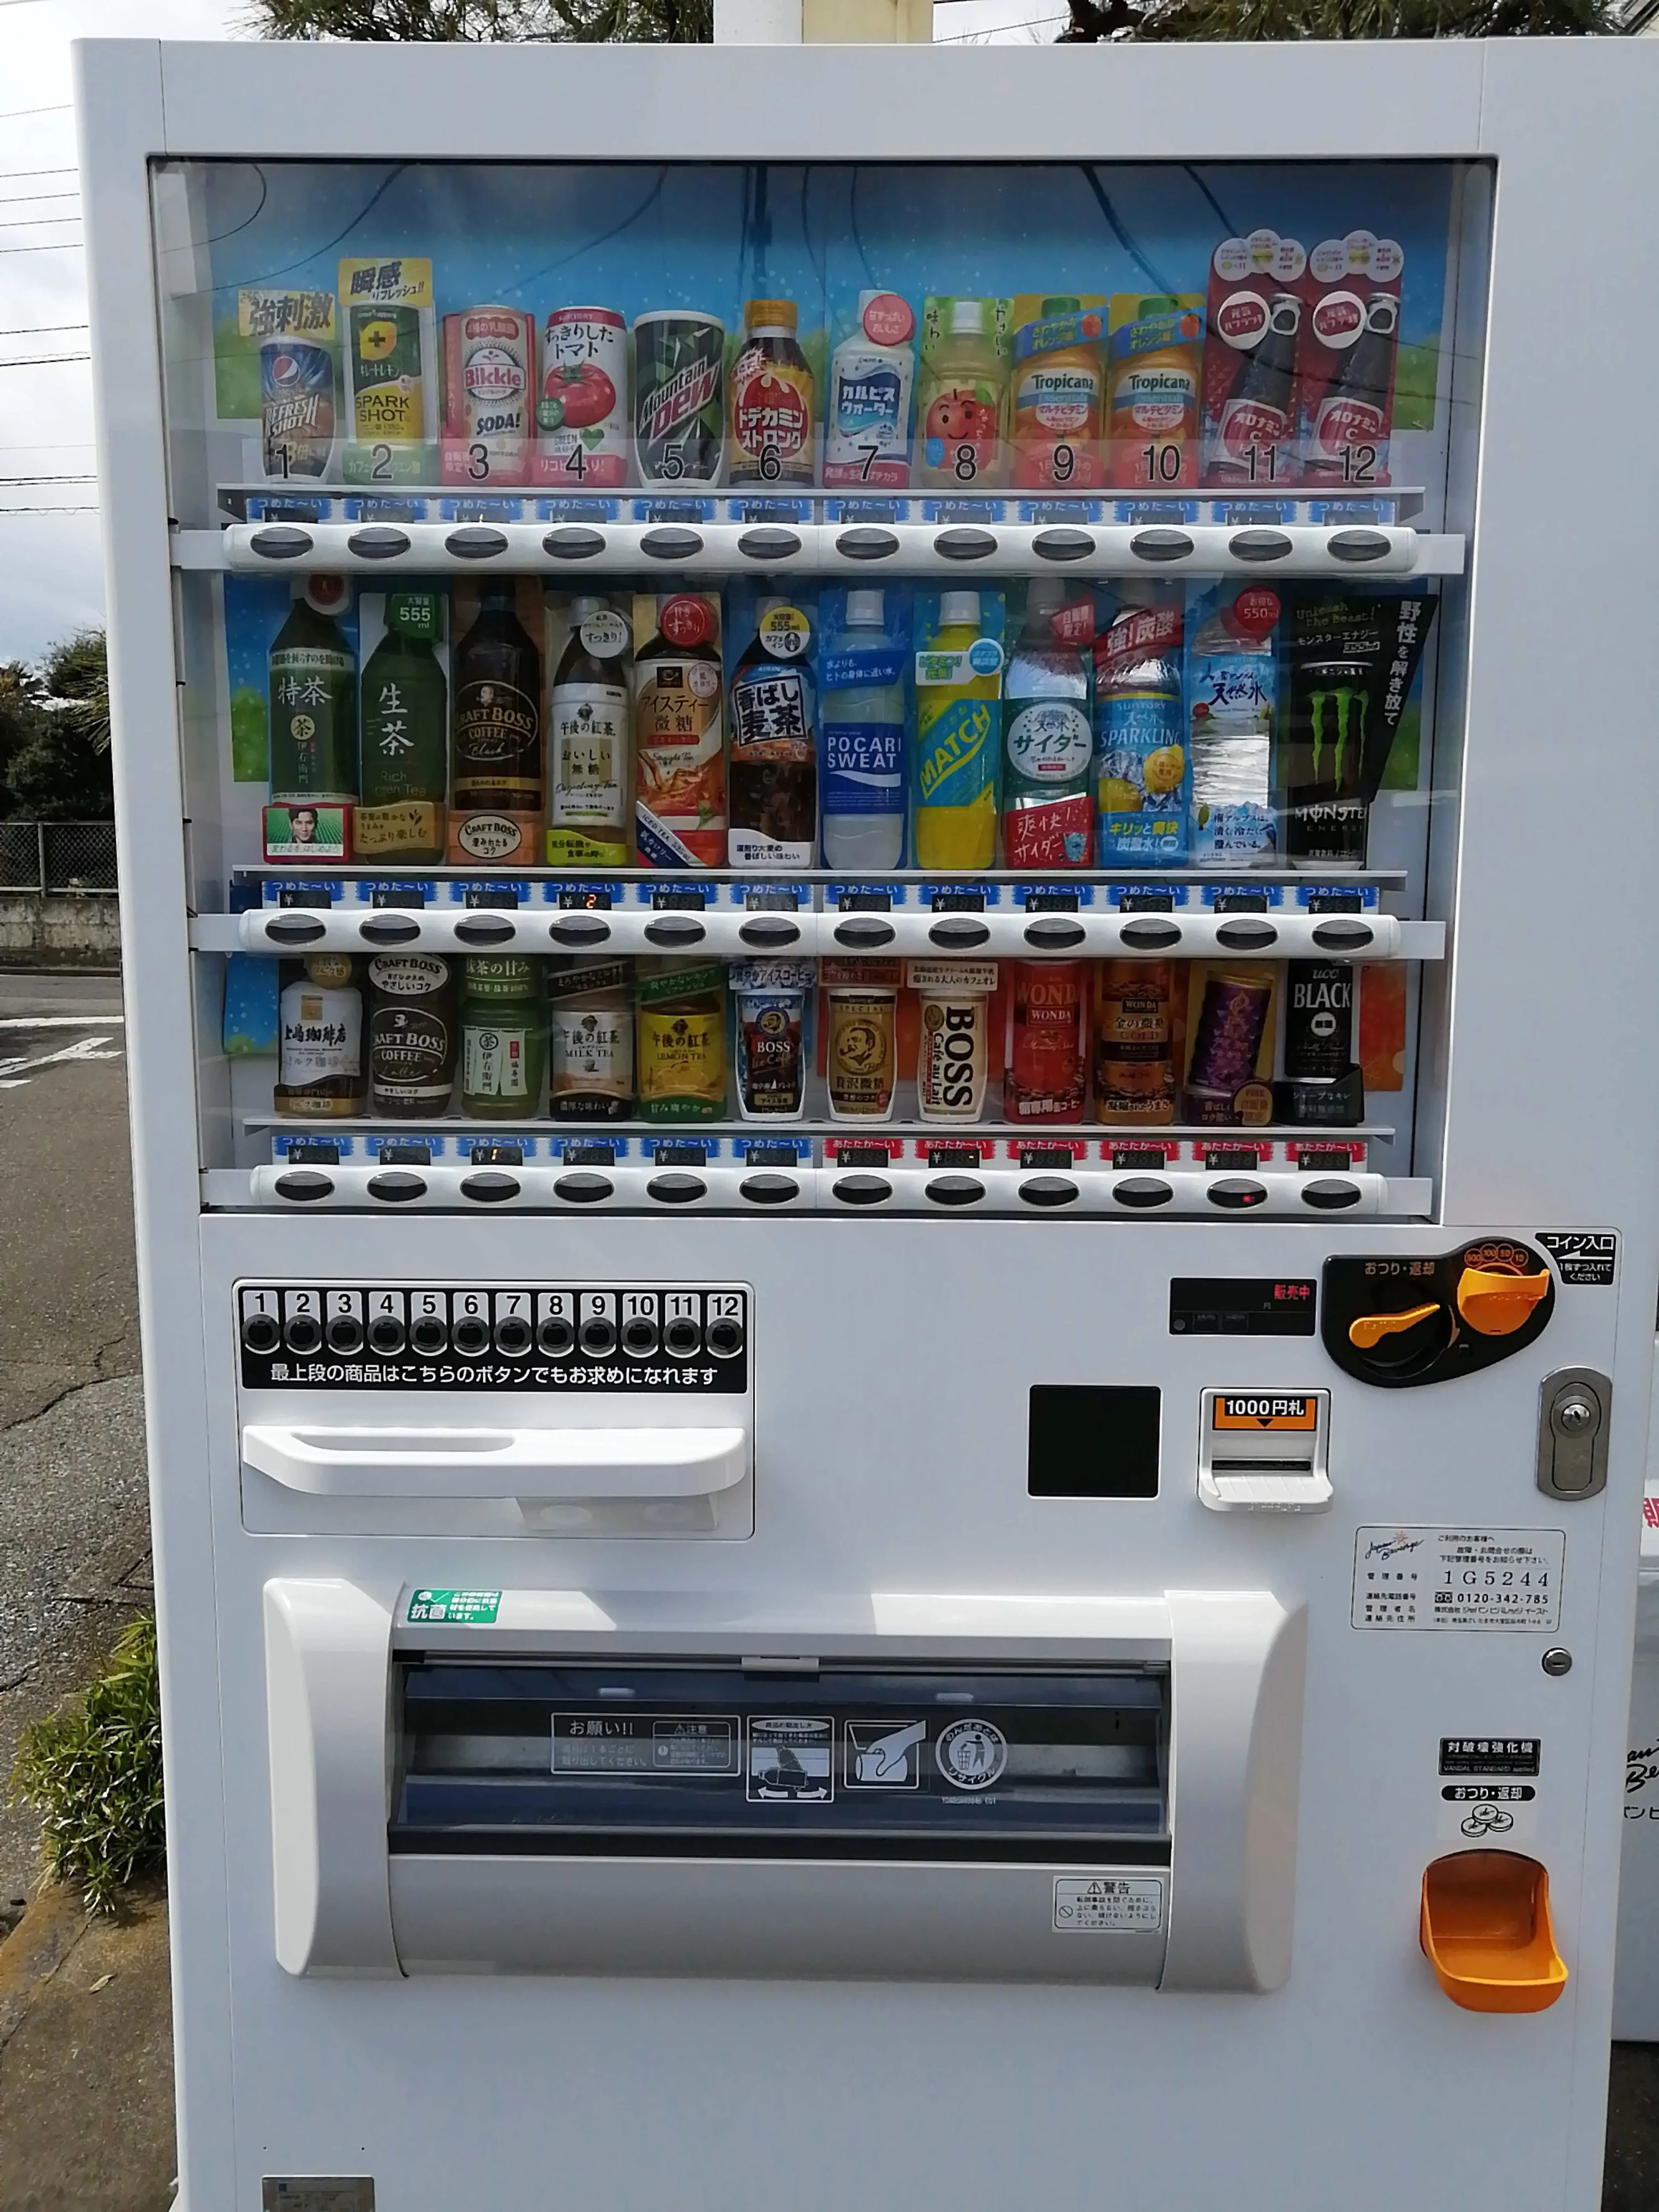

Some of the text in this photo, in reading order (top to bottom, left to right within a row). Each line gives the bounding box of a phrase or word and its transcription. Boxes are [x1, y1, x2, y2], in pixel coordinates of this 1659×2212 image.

[545, 324, 613, 343] すっきりした
[555, 341, 598, 359] トマト
[465, 368, 521, 387] Bikkle
[1032, 374, 1094, 391] Tropicana
[1129, 374, 1190, 391] Tropicana
[842, 385, 895, 401] カルピス
[357, 395, 410, 409] SPARK
[842, 403, 893, 415] ウォーター
[359, 409, 405, 422] SHOT
[739, 407, 802, 428] ドデカミン
[477, 413, 520, 435] SODA!
[742, 430, 801, 450] ストロング
[1250, 431, 1262, 442] C
[1345, 428, 1358, 439] C
[276, 444, 288, 479] 1
[372, 444, 393, 479] 2
[468, 444, 489, 479] 3
[566, 444, 586, 479] 4
[662, 444, 683, 479] 5
[760, 444, 781, 480] 6
[858, 445, 879, 480] 7
[956, 445, 977, 481] 8
[1054, 445, 1073, 481] 9
[1144, 445, 1180, 481] 10
[1245, 445, 1276, 481] 11
[1339, 446, 1375, 481] 12
[399, 607, 431, 622] 555
[1107, 611, 1175, 658] 強!炭酸
[1298, 629, 1379, 645] モンスターエナジー
[1384, 601, 1422, 726] 野性を解き放て
[278, 676, 333, 706] 特茶
[738, 683, 799, 713] 香ばし
[1208, 681, 1267, 706] 天然水
[641, 695, 709, 713] アイスティー
[378, 683, 414, 757] 生茶
[492, 706, 534, 730] BOSS
[655, 716, 693, 732] 微糖
[742, 703, 802, 742] 麦茶
[295, 719, 311, 736] 茶
[468, 727, 507, 739] COFFEE
[560, 721, 616, 737] 午後の紅茶
[828, 737, 901, 752] POCARI
[920, 705, 991, 786] MATCH
[1014, 734, 1087, 755] サイダー
[1100, 727, 1181, 748] SPARKLING
[561, 750, 612, 761] おいしい
[828, 753, 896, 768] SWEAT
[405, 784, 427, 797] Tea
[494, 823, 517, 836] BOSS
[642, 813, 670, 843] ICED TEA
[1017, 806, 1071, 841] 爽快!
[483, 847, 496, 855] コク
[1015, 832, 1063, 863] サイダー
[375, 958, 442, 973] CRAFT BOSS
[382, 981, 431, 990] やさしいコク
[1293, 982, 1352, 1008] BLACK
[1125, 1001, 1156, 1009] WONDA
[1031, 1010, 1071, 1020] WONDA
[284, 1023, 347, 1047] 上島珈琲店
[405, 1032, 445, 1051] BOSS
[565, 1049, 614, 1057] MILK TEA
[757, 1041, 791, 1053] BOSS
[381, 1050, 422, 1062] COFFEE
[943, 1005, 975, 1107] BOSS
[1547, 1237, 1614, 1250] コイン入口
[1364, 1261, 1435, 1276] おつり・返却
[1561, 1263, 1612, 1271] 1枚ずつ入れて
[1274, 1284, 1310, 1300] 販売中
[255, 1294, 739, 1316] 1 2 3 4 5 6 7 8 9 10 11 12
[270, 1364, 718, 1386] 最上段の商品はこちらのボタンでもお求めになれます
[1226, 1400, 1305, 1416] 1000円札
[1457, 1593, 1549, 1604] 0120-342-785
[411, 1604, 447, 1619] 抗菌
[570, 1720, 633, 1736] お願い!!
[686, 1724, 707, 1735] 注意
[1448, 1741, 1533, 1753] 対破壊強化機
[561, 1756, 647, 1767] 取り出してください。
[947, 1767, 995, 1784] リサイクル
[1455, 1787, 1522, 1799] おつり・返却
[1104, 1882, 1130, 1894] 警告
